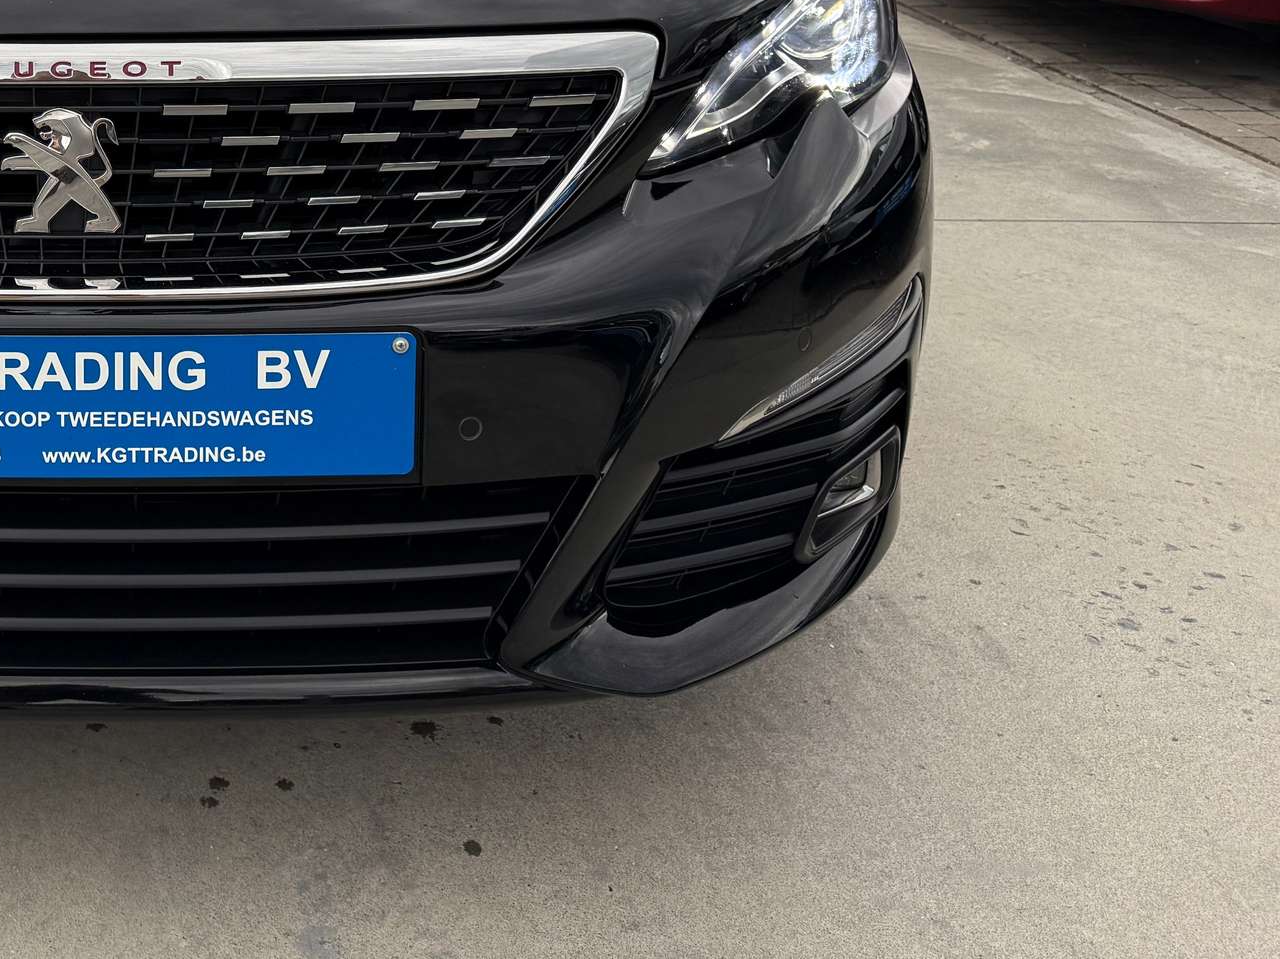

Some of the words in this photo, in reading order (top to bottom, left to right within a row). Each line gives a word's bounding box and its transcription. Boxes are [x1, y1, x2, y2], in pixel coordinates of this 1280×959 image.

[257, 349, 331, 390] BV
[56, 409, 314, 428] TWEEDEHANDSWAGENS
[42, 445, 266, 464] www.KGTTRADING.be
